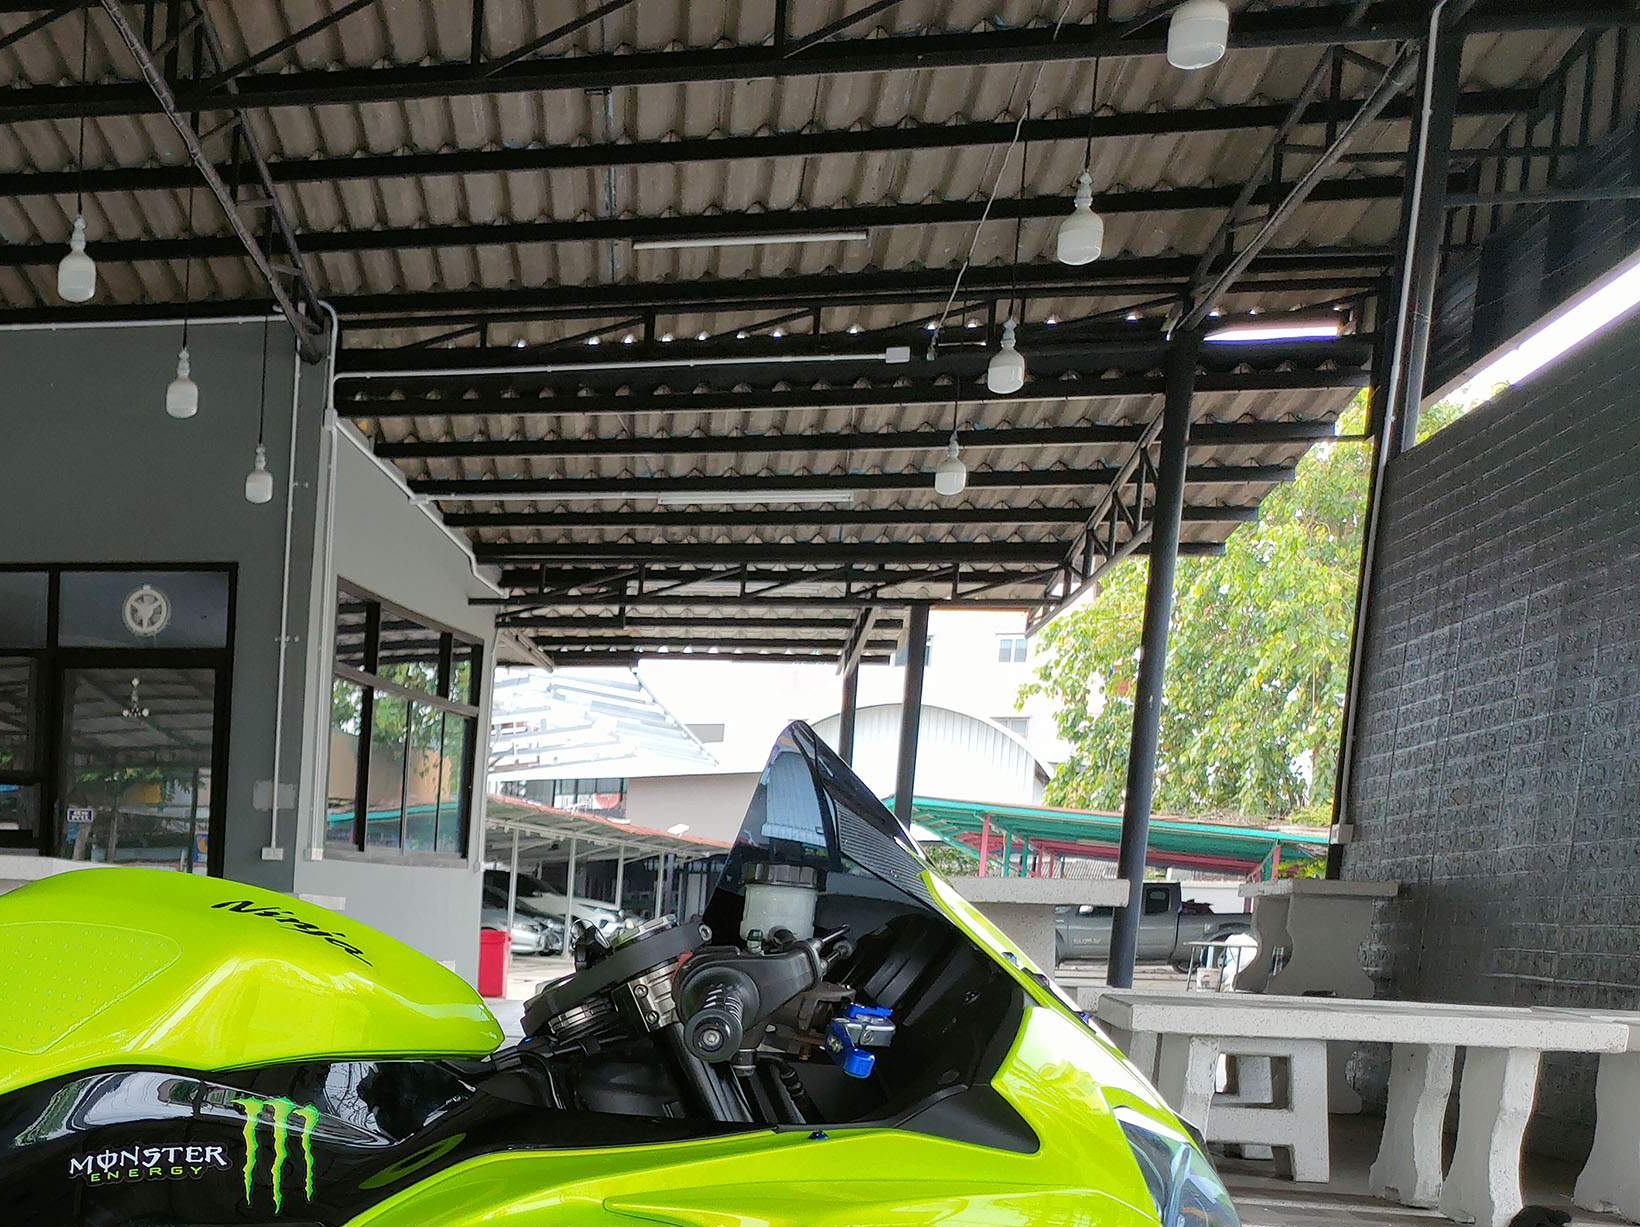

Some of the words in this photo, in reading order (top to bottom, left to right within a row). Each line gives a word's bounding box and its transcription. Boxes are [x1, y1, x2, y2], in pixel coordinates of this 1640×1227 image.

[211, 900, 373, 968] Ninja
[70, 1145, 227, 1175] MONSTER
[91, 1165, 203, 1182] ENERGY
